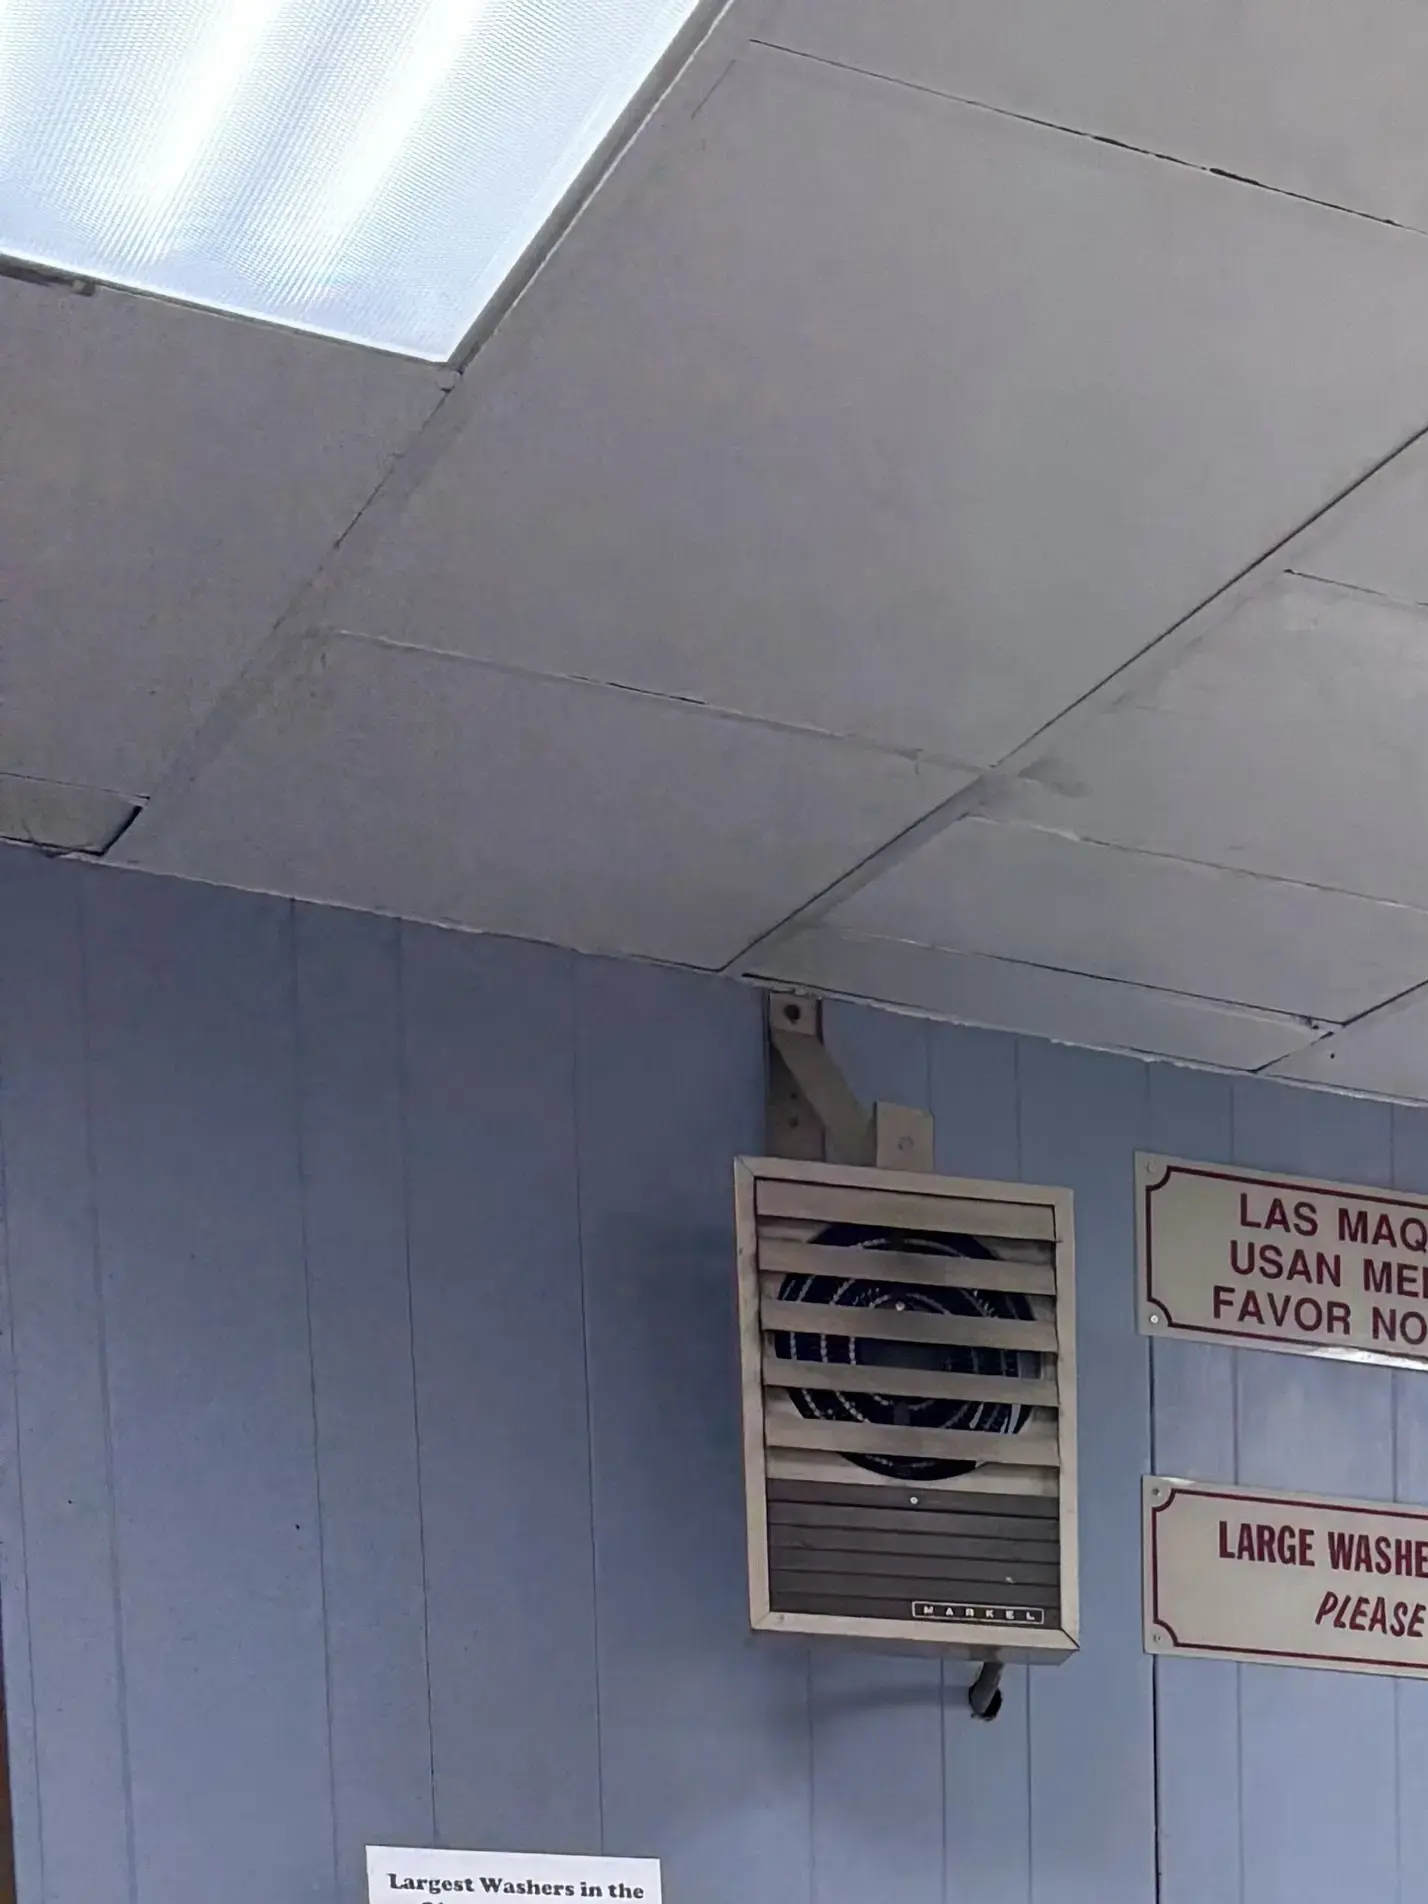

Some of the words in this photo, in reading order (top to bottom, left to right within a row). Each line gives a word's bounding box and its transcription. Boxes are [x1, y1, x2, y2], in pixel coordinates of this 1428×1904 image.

[1239, 1192, 1319, 1238] LAS
[1229, 1240, 1342, 1288] USAN
[1213, 1285, 1352, 1336] FAVOR
[1372, 1306, 1428, 1344] NO
[1218, 1520, 1315, 1567] LARGE
[923, 1605, 1036, 1620] MARKEL
[1314, 1591, 1425, 1639] PLEASE
[388, 1872, 475, 1895] Largest
[479, 1877, 575, 1897] Washers
[580, 1881, 602, 1897] in
[608, 1882, 645, 1899] the
